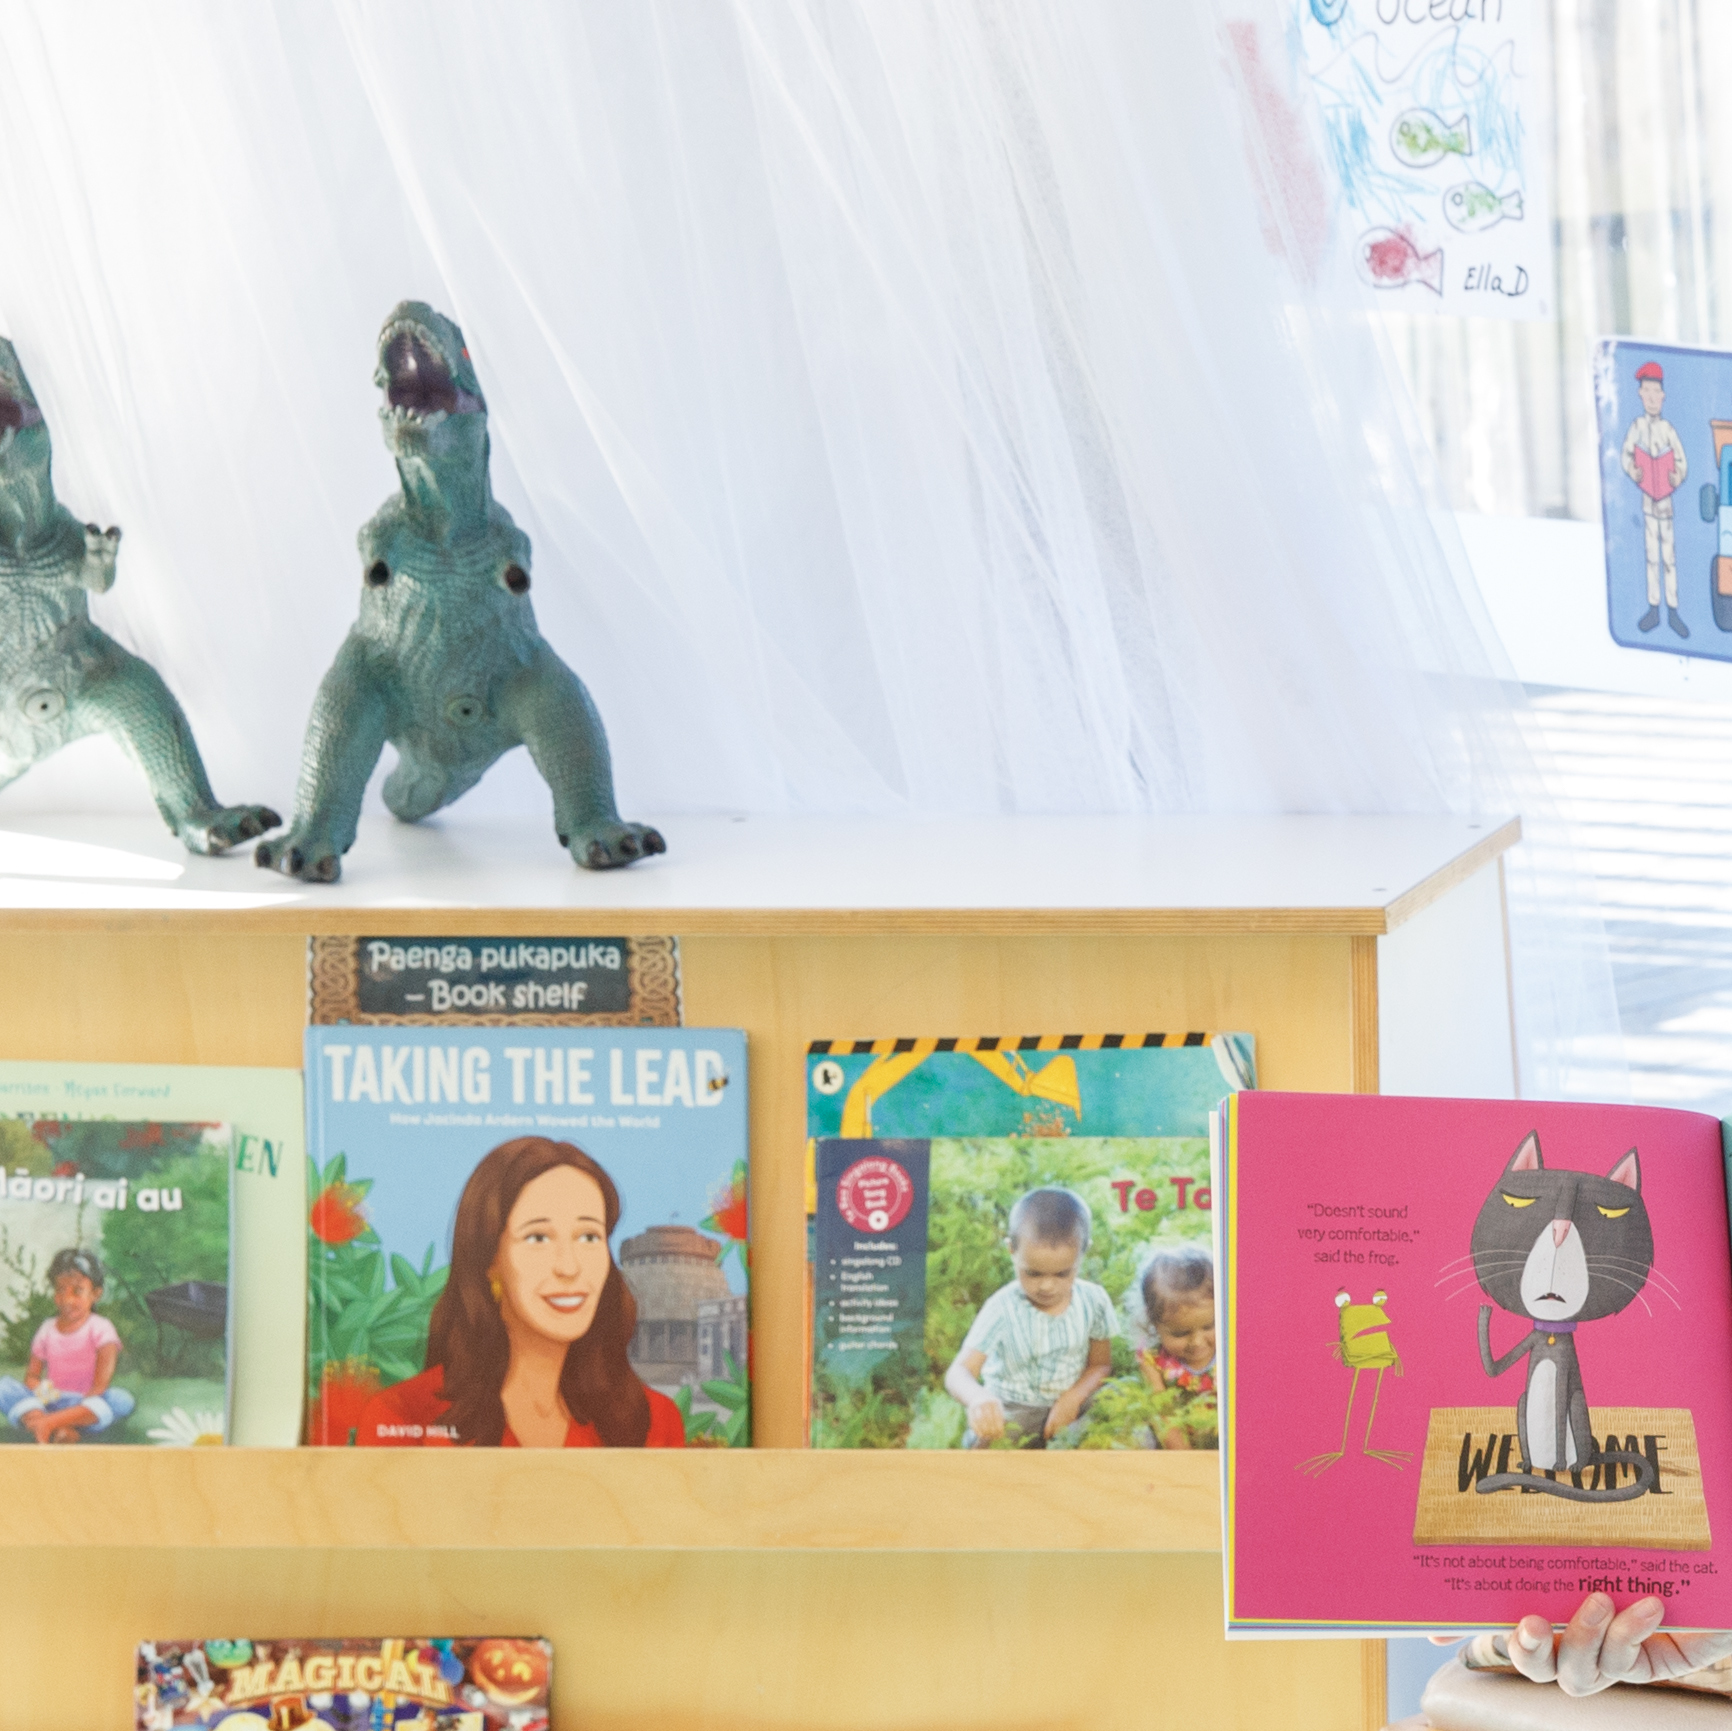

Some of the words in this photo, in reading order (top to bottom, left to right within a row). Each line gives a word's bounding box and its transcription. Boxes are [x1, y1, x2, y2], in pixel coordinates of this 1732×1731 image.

[1464, 265, 1502, 295] Ella
[366, 941, 473, 974] Paenga
[480, 940, 622, 974] pukapuka
[428, 979, 506, 1012] Book
[511, 980, 588, 1011] shelf
[322, 1044, 492, 1107] TAKING
[503, 1048, 595, 1107] THE
[609, 1049, 725, 1109] LEAD
[93, 1176, 129, 1212] ai
[136, 1186, 183, 1213] au
[1110, 1180, 1158, 1214] Te
[1368, 1205, 1409, 1220] sound
[1298, 1228, 1325, 1243] very
[1314, 1249, 1341, 1264] said
[1343, 1250, 1365, 1265] the
[1368, 1250, 1400, 1268] frog.
[1458, 1432, 1674, 1495] WEOME
[1443, 1556, 1466, 1570] not
[1467, 1556, 1508, 1571] about
[1509, 1557, 1545, 1573] being
[1640, 1559, 1667, 1574] said
[1668, 1560, 1692, 1574] the
[1693, 1561, 1719, 1576] cat.
[1474, 1577, 1513, 1592] about
[1515, 1578, 1551, 1595] doing
[1553, 1579, 1575, 1593] the
[1578, 1576, 1624, 1594] right
[227, 1655, 452, 1707] MAGICAL
